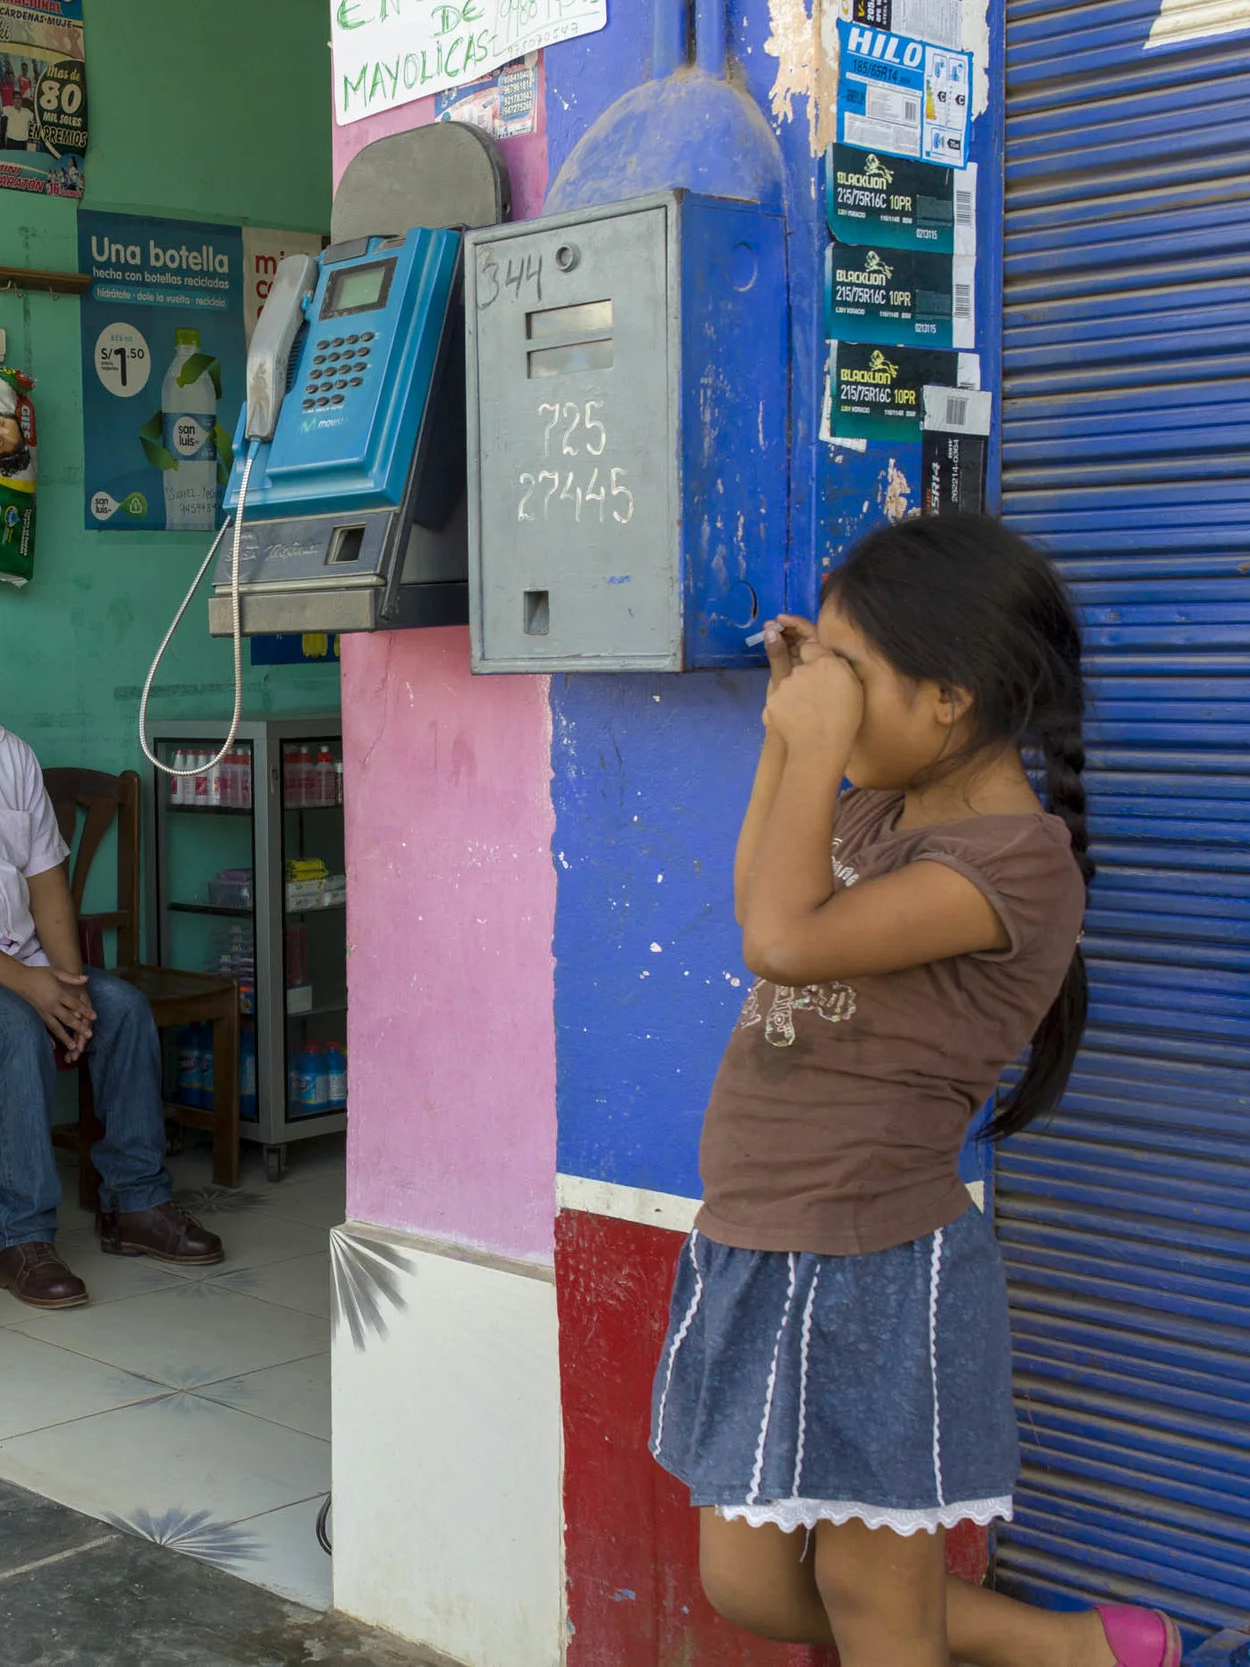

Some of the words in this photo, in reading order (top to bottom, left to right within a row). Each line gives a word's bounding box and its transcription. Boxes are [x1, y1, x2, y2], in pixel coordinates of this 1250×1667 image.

[848, 27, 923, 68] HILO
[344, 29, 489, 112] MAYOLICAS
[853, 60, 898, 82] 185/65R14
[40, 80, 82, 114] 80
[43, 112, 58, 123] MIL
[60, 116, 82, 127] SOLES
[28, 121, 42, 139] EN
[44, 126, 87, 147] PREMIOS
[838, 172, 886, 190] BLACKLION
[838, 188, 886, 208] 215/75R16C
[889, 195, 912, 212] 10PR
[91, 235, 141, 265] Una
[150, 240, 229, 273] botella
[93, 266, 122, 279] hecha
[125, 270, 142, 281] con
[145, 271, 182, 285] botellas
[184, 277, 229, 289] recicladas
[475, 254, 542, 310] 344
[836, 269, 886, 286] BLACKLION
[836, 286, 886, 305] 215/75R16C
[889, 290, 911, 307] 10PR
[841, 368, 891, 384] BLACKLION
[841, 385, 891, 403] 215/75R16C
[894, 389, 916, 405] 10PR
[178, 425, 195, 435] san
[538, 401, 607, 456] 725
[179, 435, 194, 446] luis
[517, 467, 635, 524] 27445
[95, 505, 107, 514] luis
